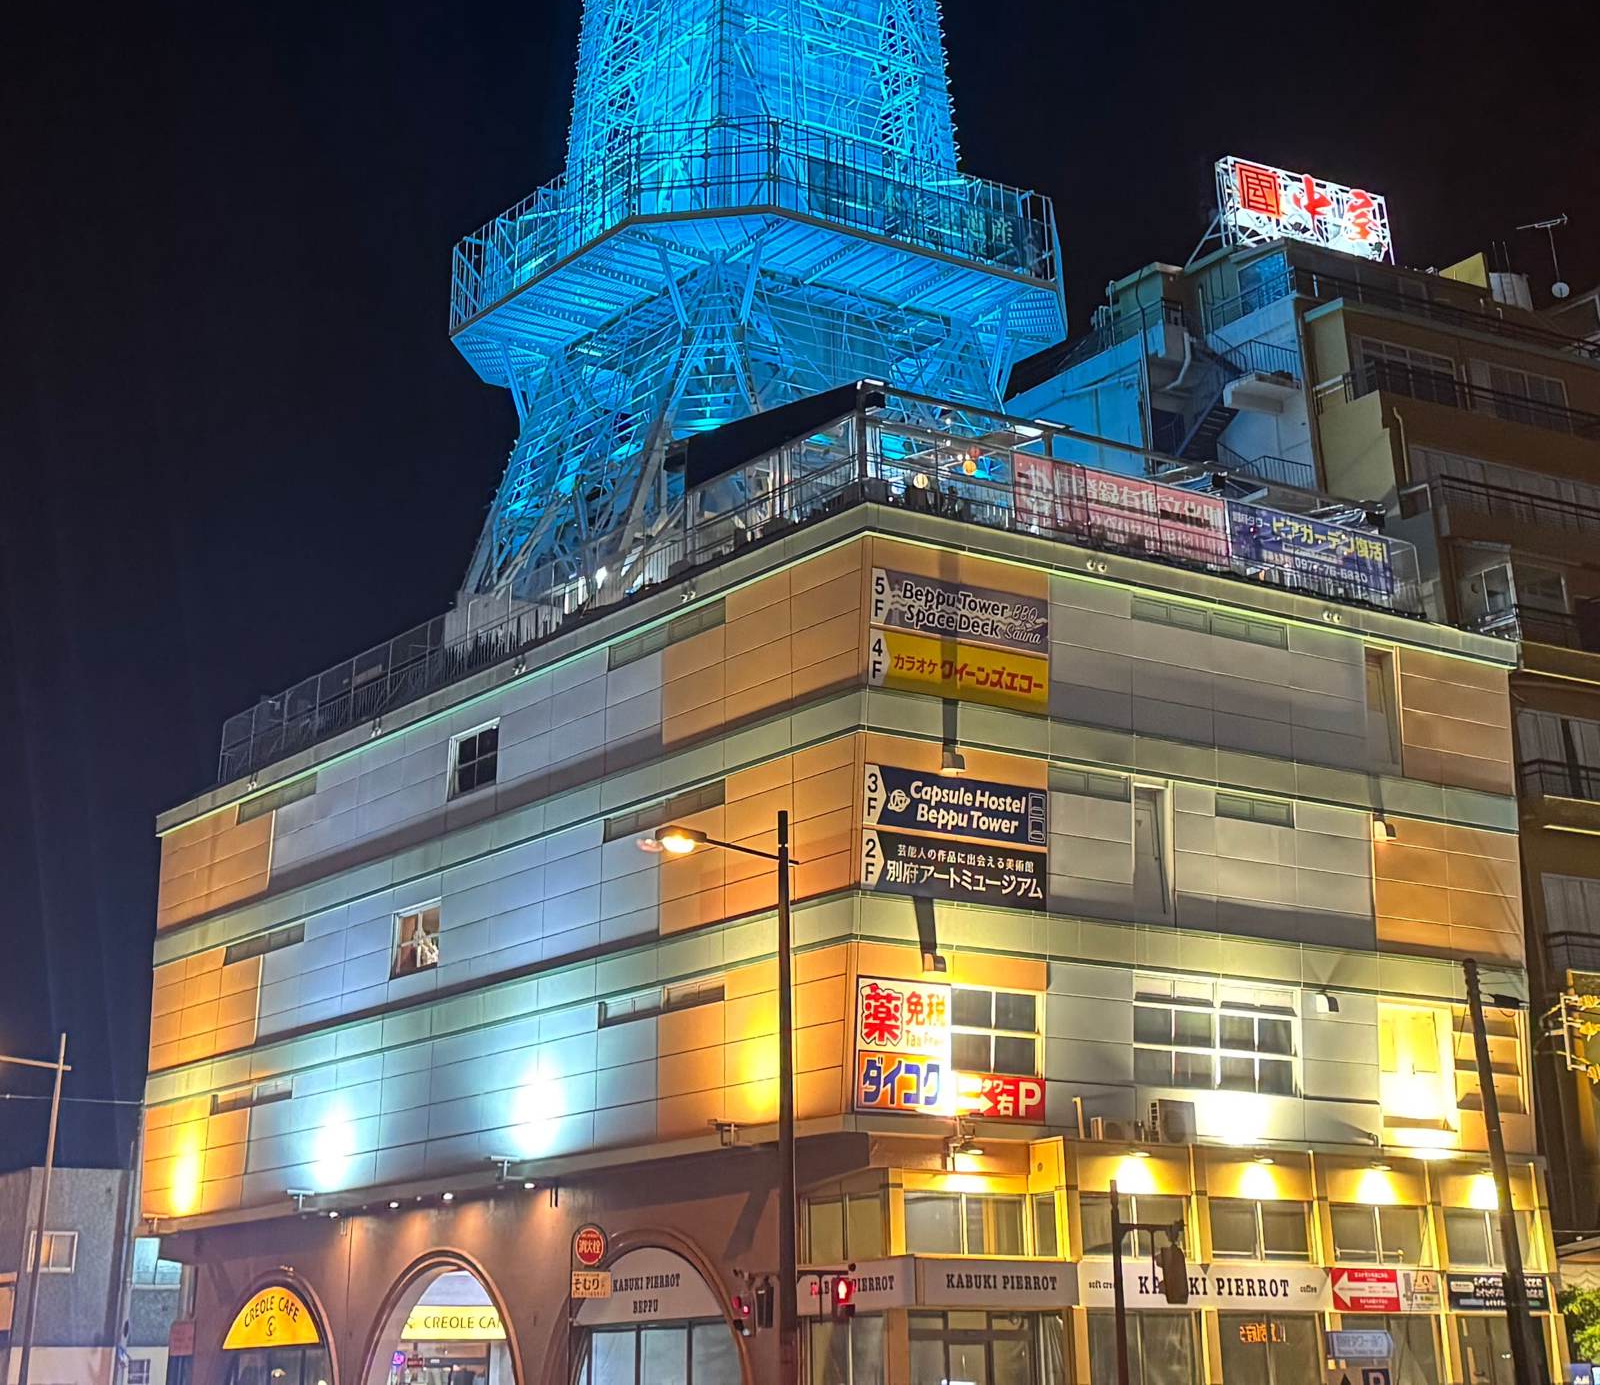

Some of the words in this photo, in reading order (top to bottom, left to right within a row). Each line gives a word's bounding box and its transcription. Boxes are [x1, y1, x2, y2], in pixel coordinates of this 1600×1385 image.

[902, 582, 956, 610] Beppu
[960, 593, 1008, 616] Tower
[1012, 605, 1038, 622] BBQ
[906, 605, 955, 628] Space
[958, 615, 1000, 637] Deck
[1005, 624, 1041, 644] Sauna
[893, 655, 938, 674] カラオケ
[941, 660, 1043, 694] クイーンズエコー
[910, 780, 973, 807] Capsule
[975, 790, 1026, 814] Hostel
[917, 804, 968, 830] Beppu
[970, 811, 1019, 834] Tower
[897, 844, 1034, 873] 芸能人の作品に出会える美術館
[886, 860, 1043, 899] 別府アートミュージアム
[862, 983, 902, 1044] 薬
[905, 991, 946, 1027] 免税
[863, 1057, 940, 1105] ダイコク
[997, 1094, 1014, 1116] 右
[1019, 1082, 1041, 1116] P
[578, 1239, 601, 1254] 消火栓
[613, 1276, 643, 1293] KABUKI
[646, 1273, 681, 1289] PIERROT
[946, 1273, 998, 1290] KABUKI
[1002, 1275, 1057, 1291] PIERROT
[1138, 1276, 1208, 1296] KAKI
[1216, 1277, 1289, 1297] PIERROT
[1299, 1284, 1317, 1294] coffee
[244, 1295, 275, 1327] CREOLE
[278, 1297, 300, 1323] CAFE
[633, 1299, 659, 1314] BEPPU
[424, 1316, 474, 1329] CREOLE
[478, 1316, 500, 1329] CA
